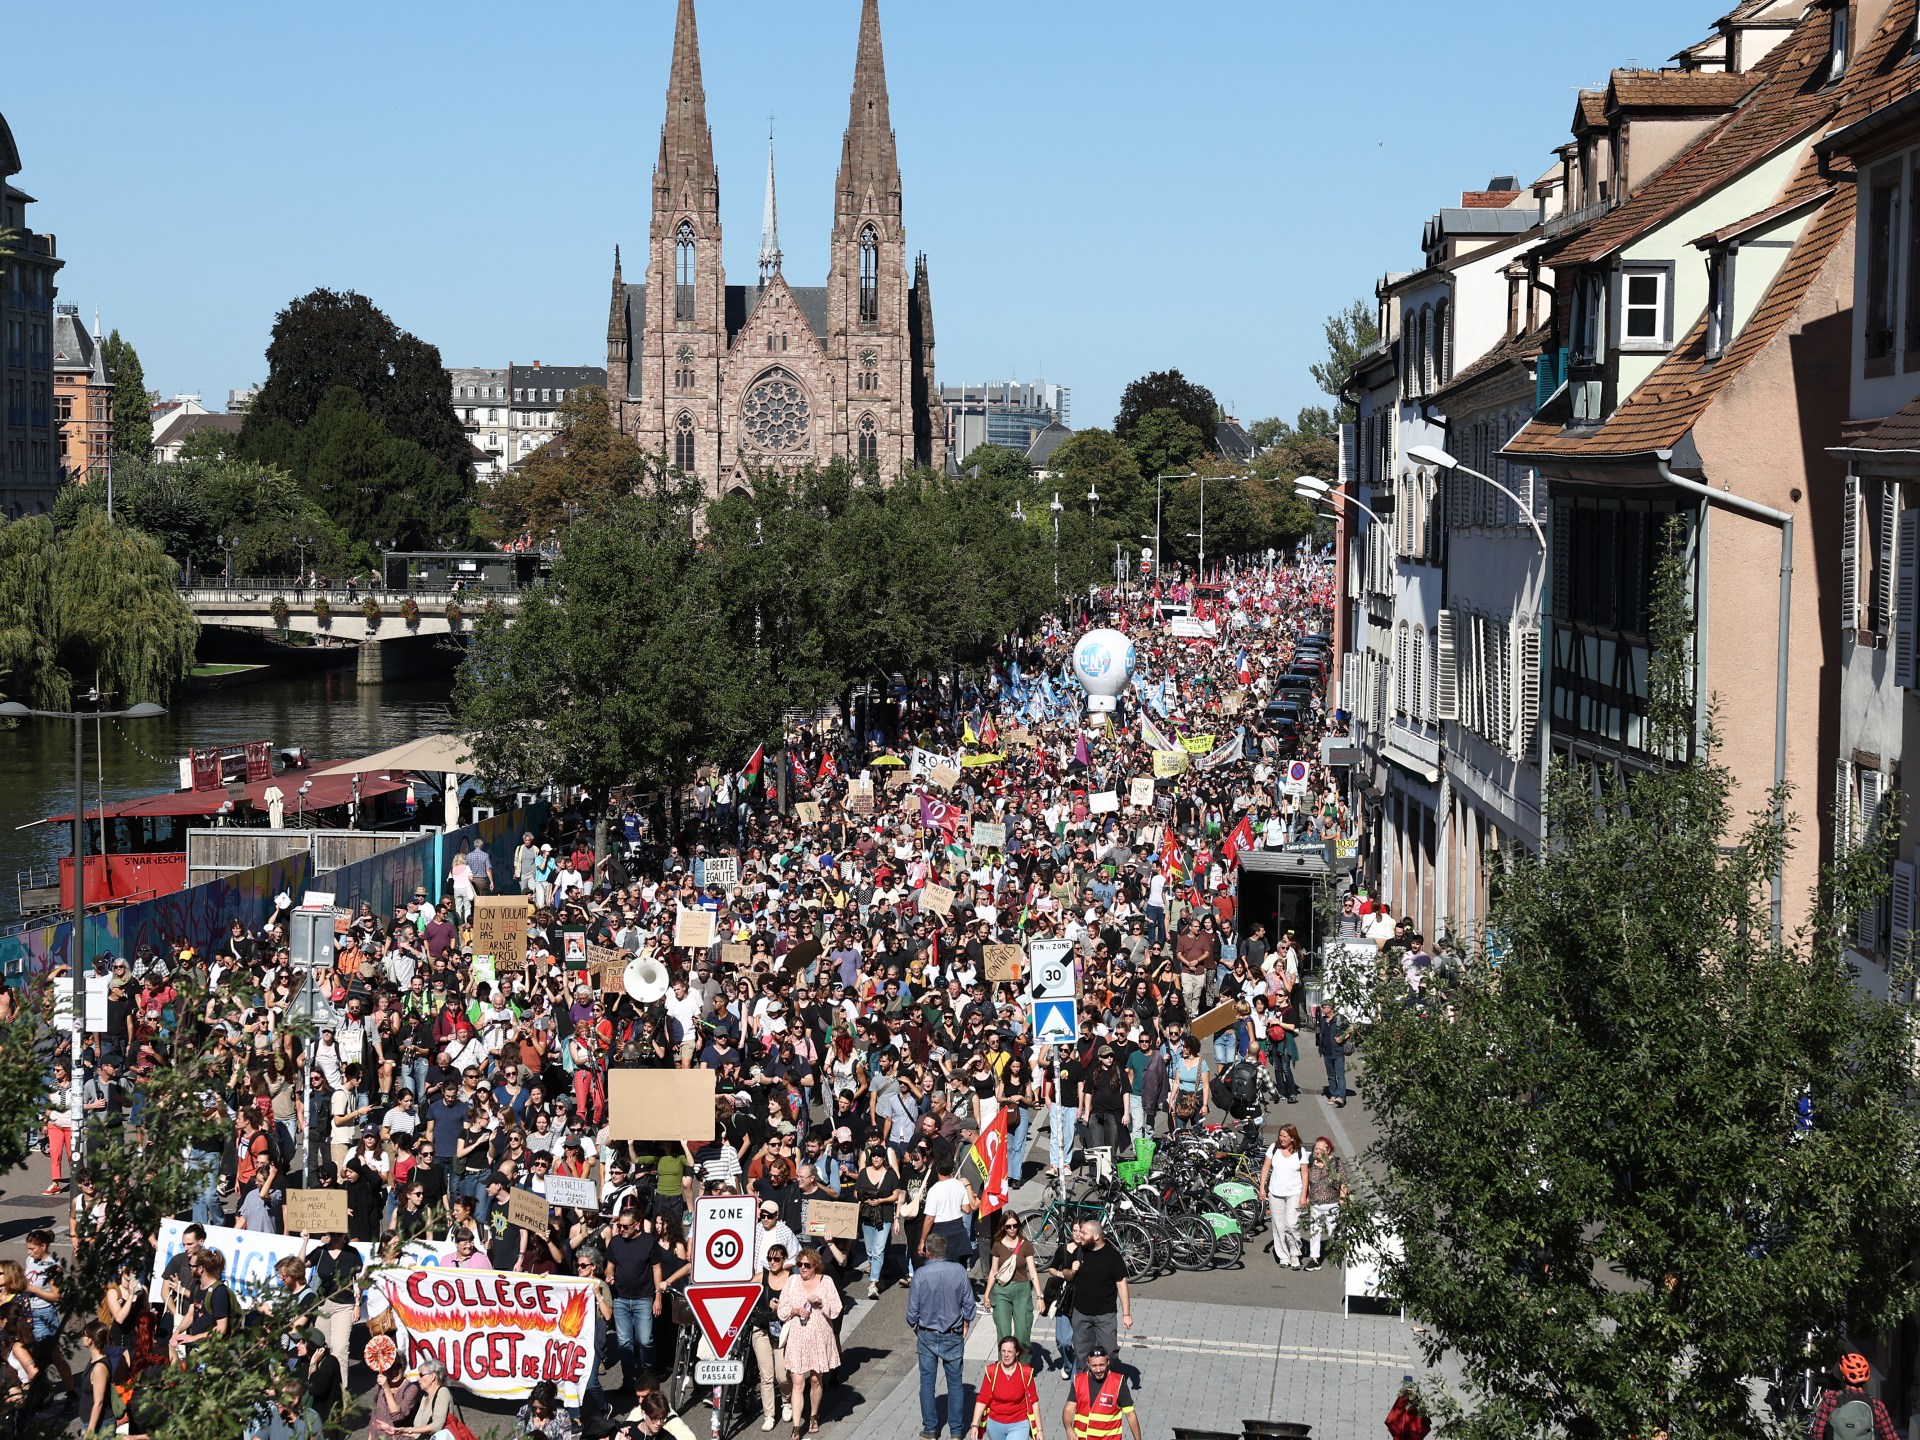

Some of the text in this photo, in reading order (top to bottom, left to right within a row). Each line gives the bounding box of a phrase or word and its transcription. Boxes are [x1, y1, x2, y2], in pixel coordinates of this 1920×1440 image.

[1286, 843, 1326, 851] Saint-Guillaume
[480, 907, 495, 920] ON
[480, 921, 522, 932] UN BBL
[480, 931, 516, 941] PAS UN
[482, 941, 520, 952] BARNIER
[482, 951, 518, 961] YROU
[1045, 969, 1062, 981] 30
[290, 1191, 298, 1202] A
[710, 1208, 743, 1220] ZONE
[713, 1241, 736, 1258] 30
[406, 1271, 558, 1315] COLLÈGE
[701, 1364, 726, 1373] CÉDEZ
